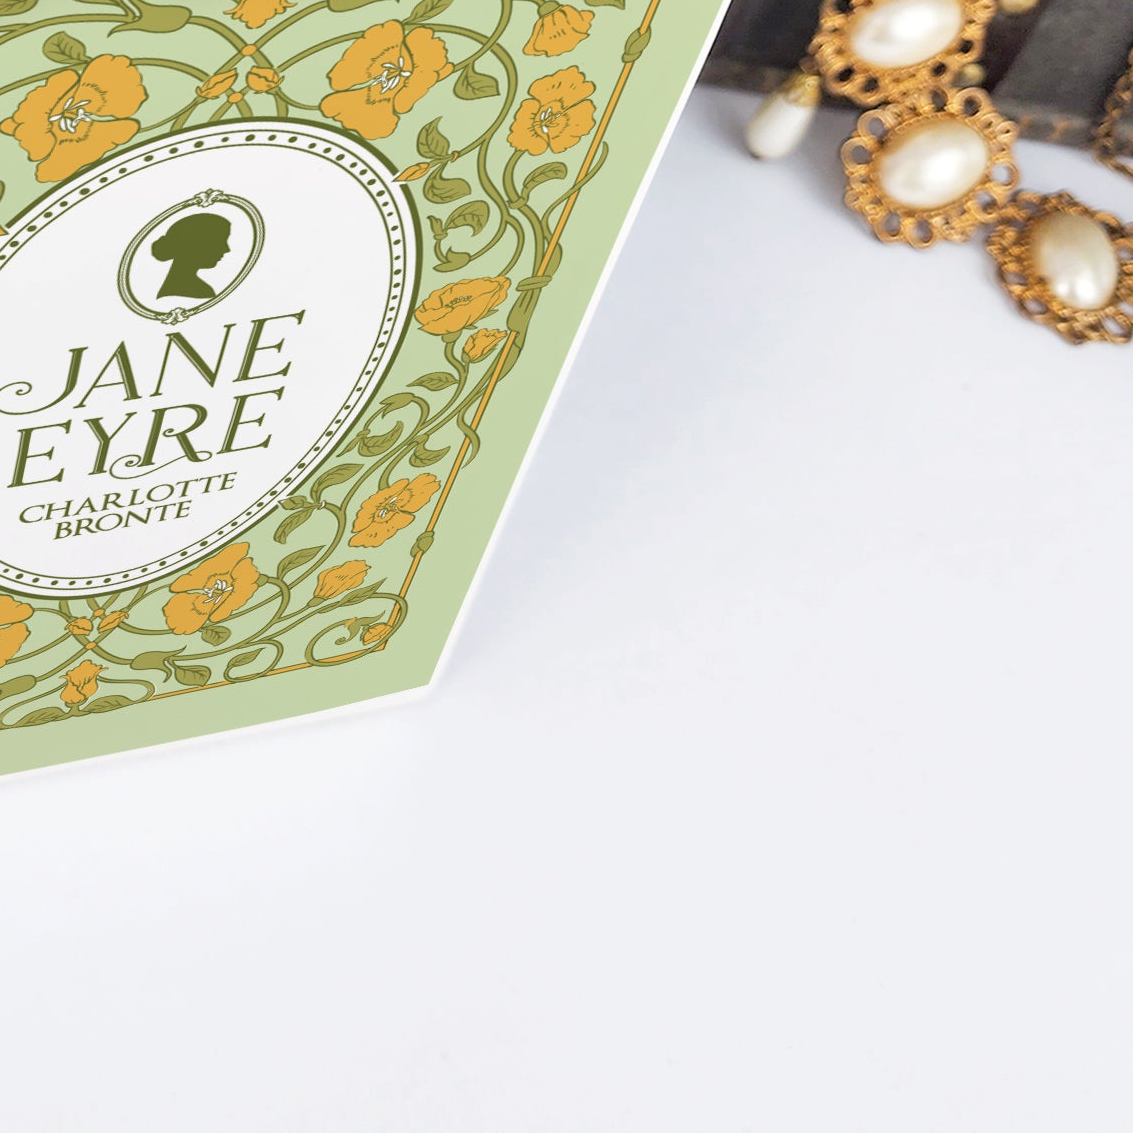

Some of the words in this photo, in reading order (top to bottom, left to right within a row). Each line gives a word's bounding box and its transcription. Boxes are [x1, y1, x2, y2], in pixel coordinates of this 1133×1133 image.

[7, 386, 285, 488] EYRE
[19, 472, 237, 524] CHARLOTTE
[54, 500, 192, 540] BRONTE
